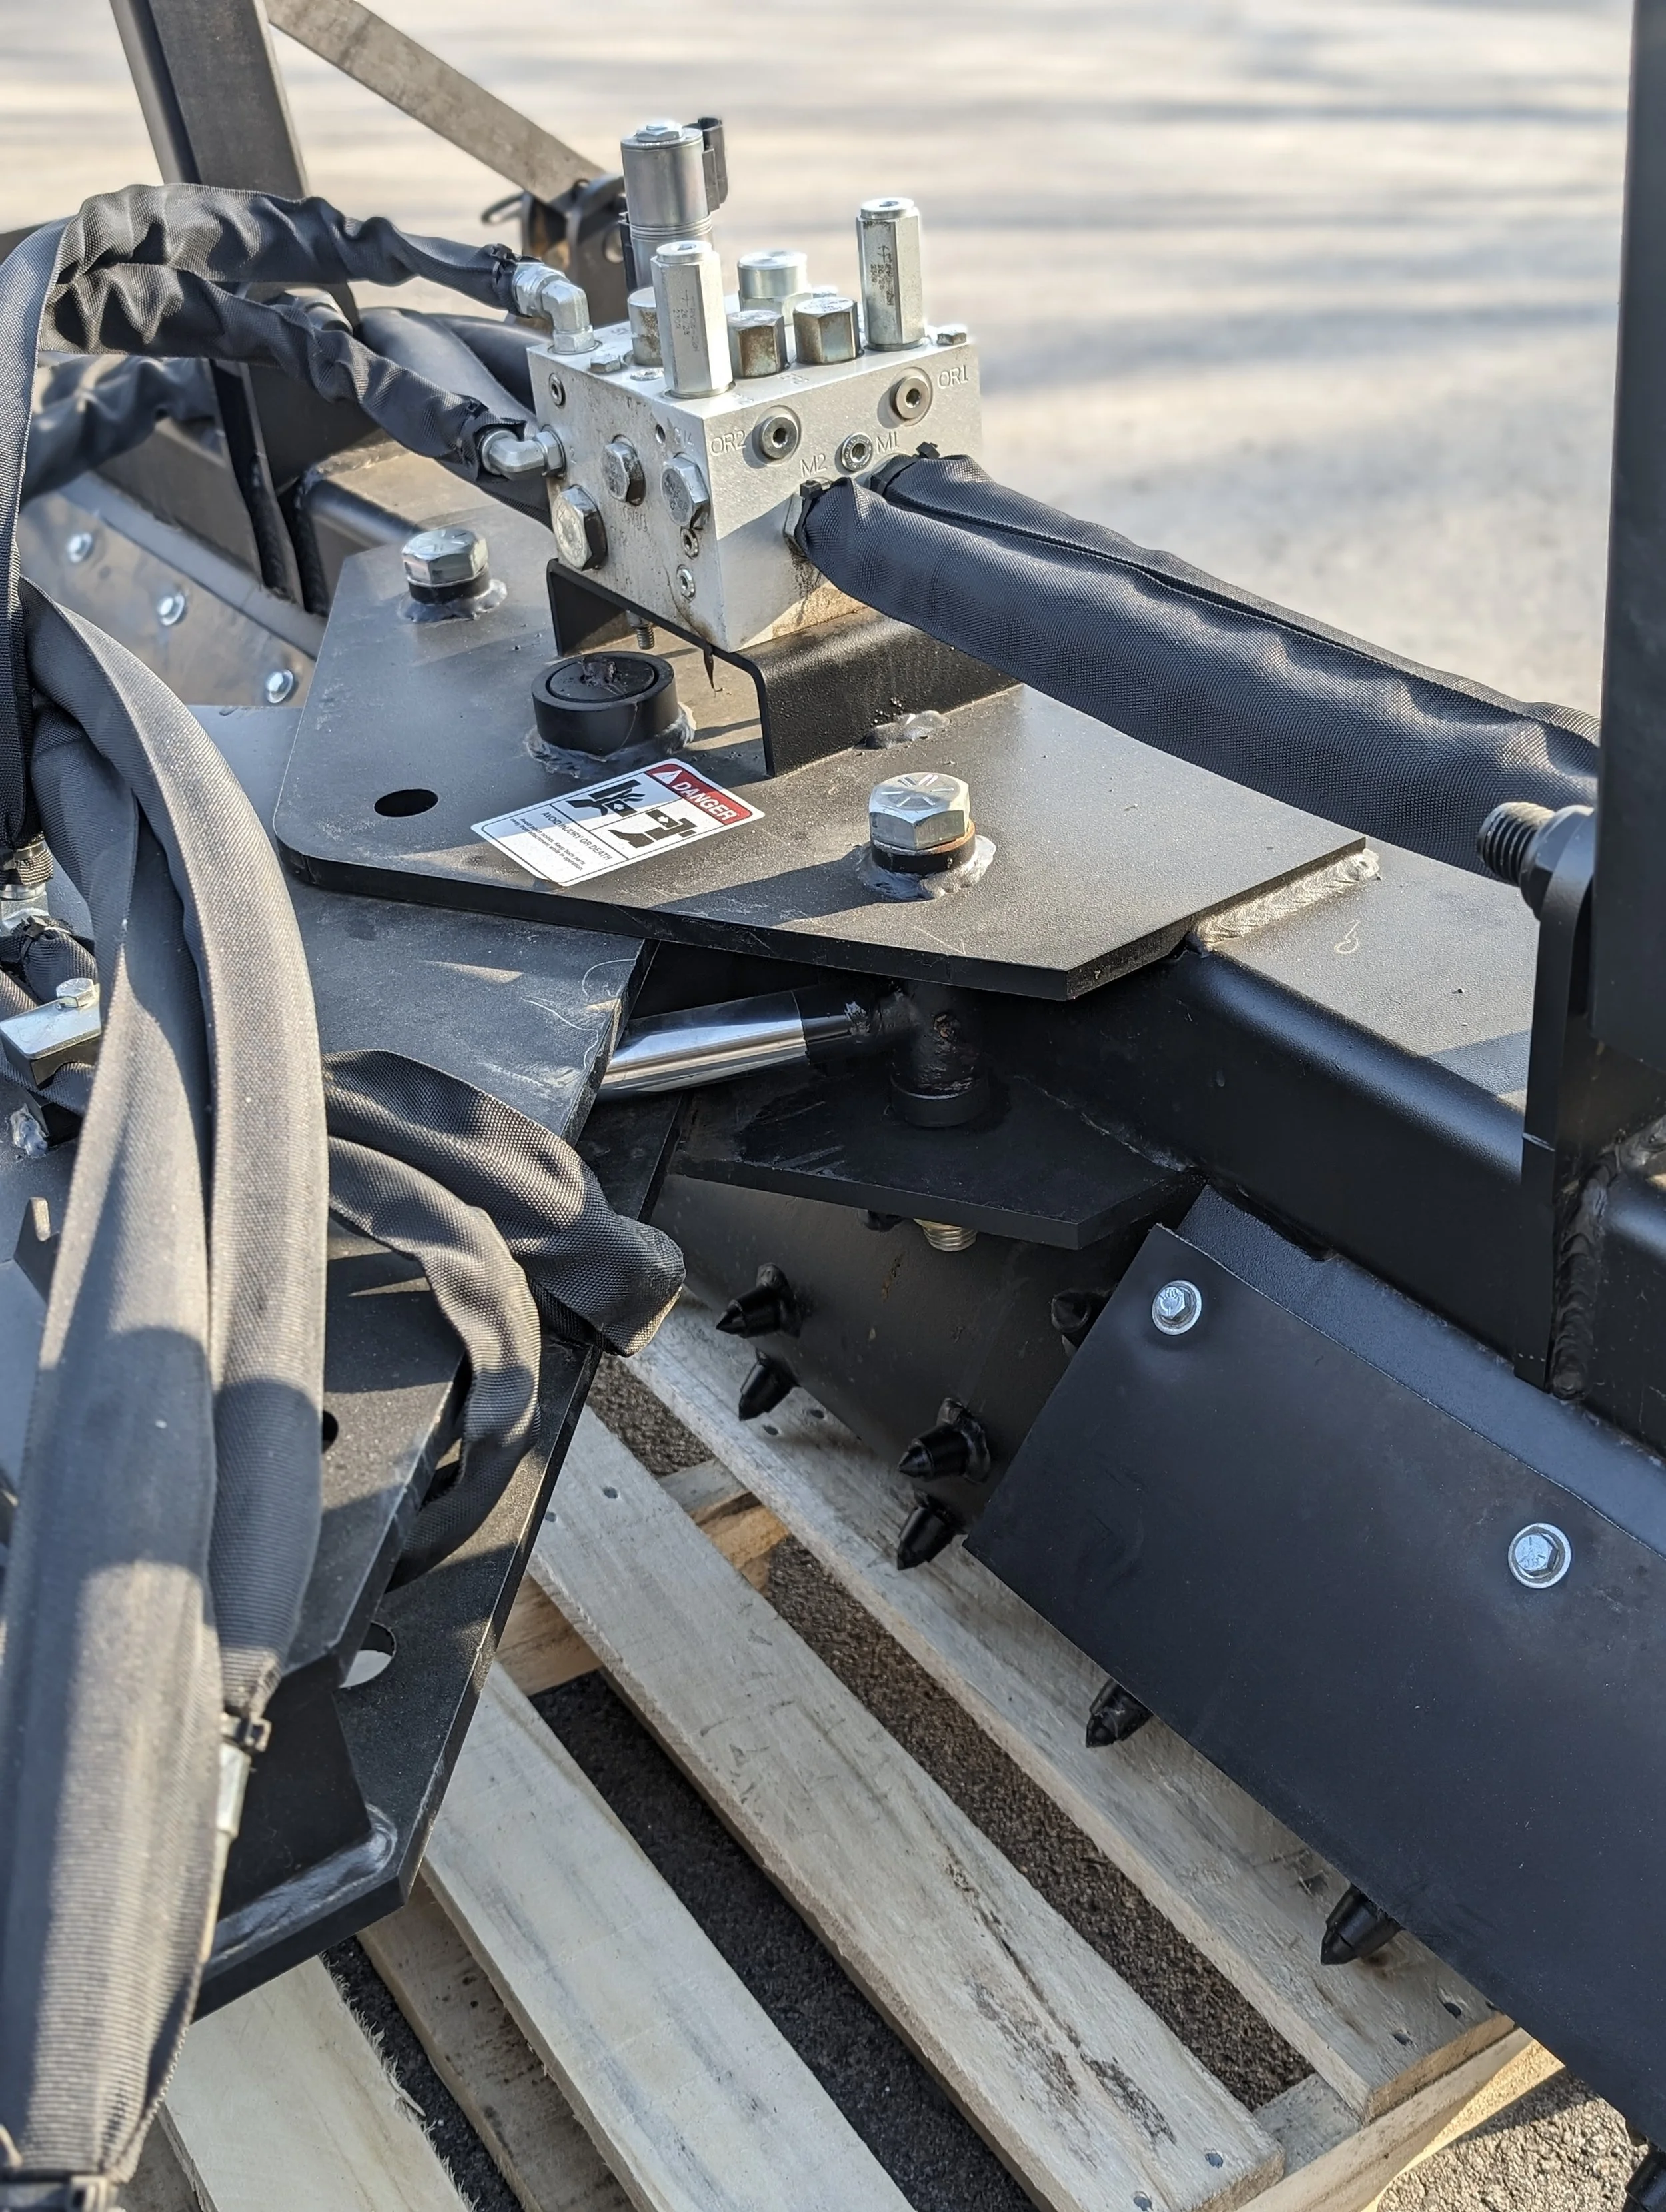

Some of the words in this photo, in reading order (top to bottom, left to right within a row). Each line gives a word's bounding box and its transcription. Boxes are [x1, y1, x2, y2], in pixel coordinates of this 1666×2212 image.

[937, 364, 969, 390] OR1
[710, 430, 746, 456] OR2
[876, 430, 900, 454] M1
[800, 453, 827, 478] M2
[672, 781, 738, 821] DANGER
[541, 812, 562, 826] AVOID
[560, 824, 582, 839] INJURY
[580, 838, 590, 847] OR
[589, 844, 613, 861] DEATH
[554, 842, 566, 851] Keep
[564, 848, 575, 859] body
